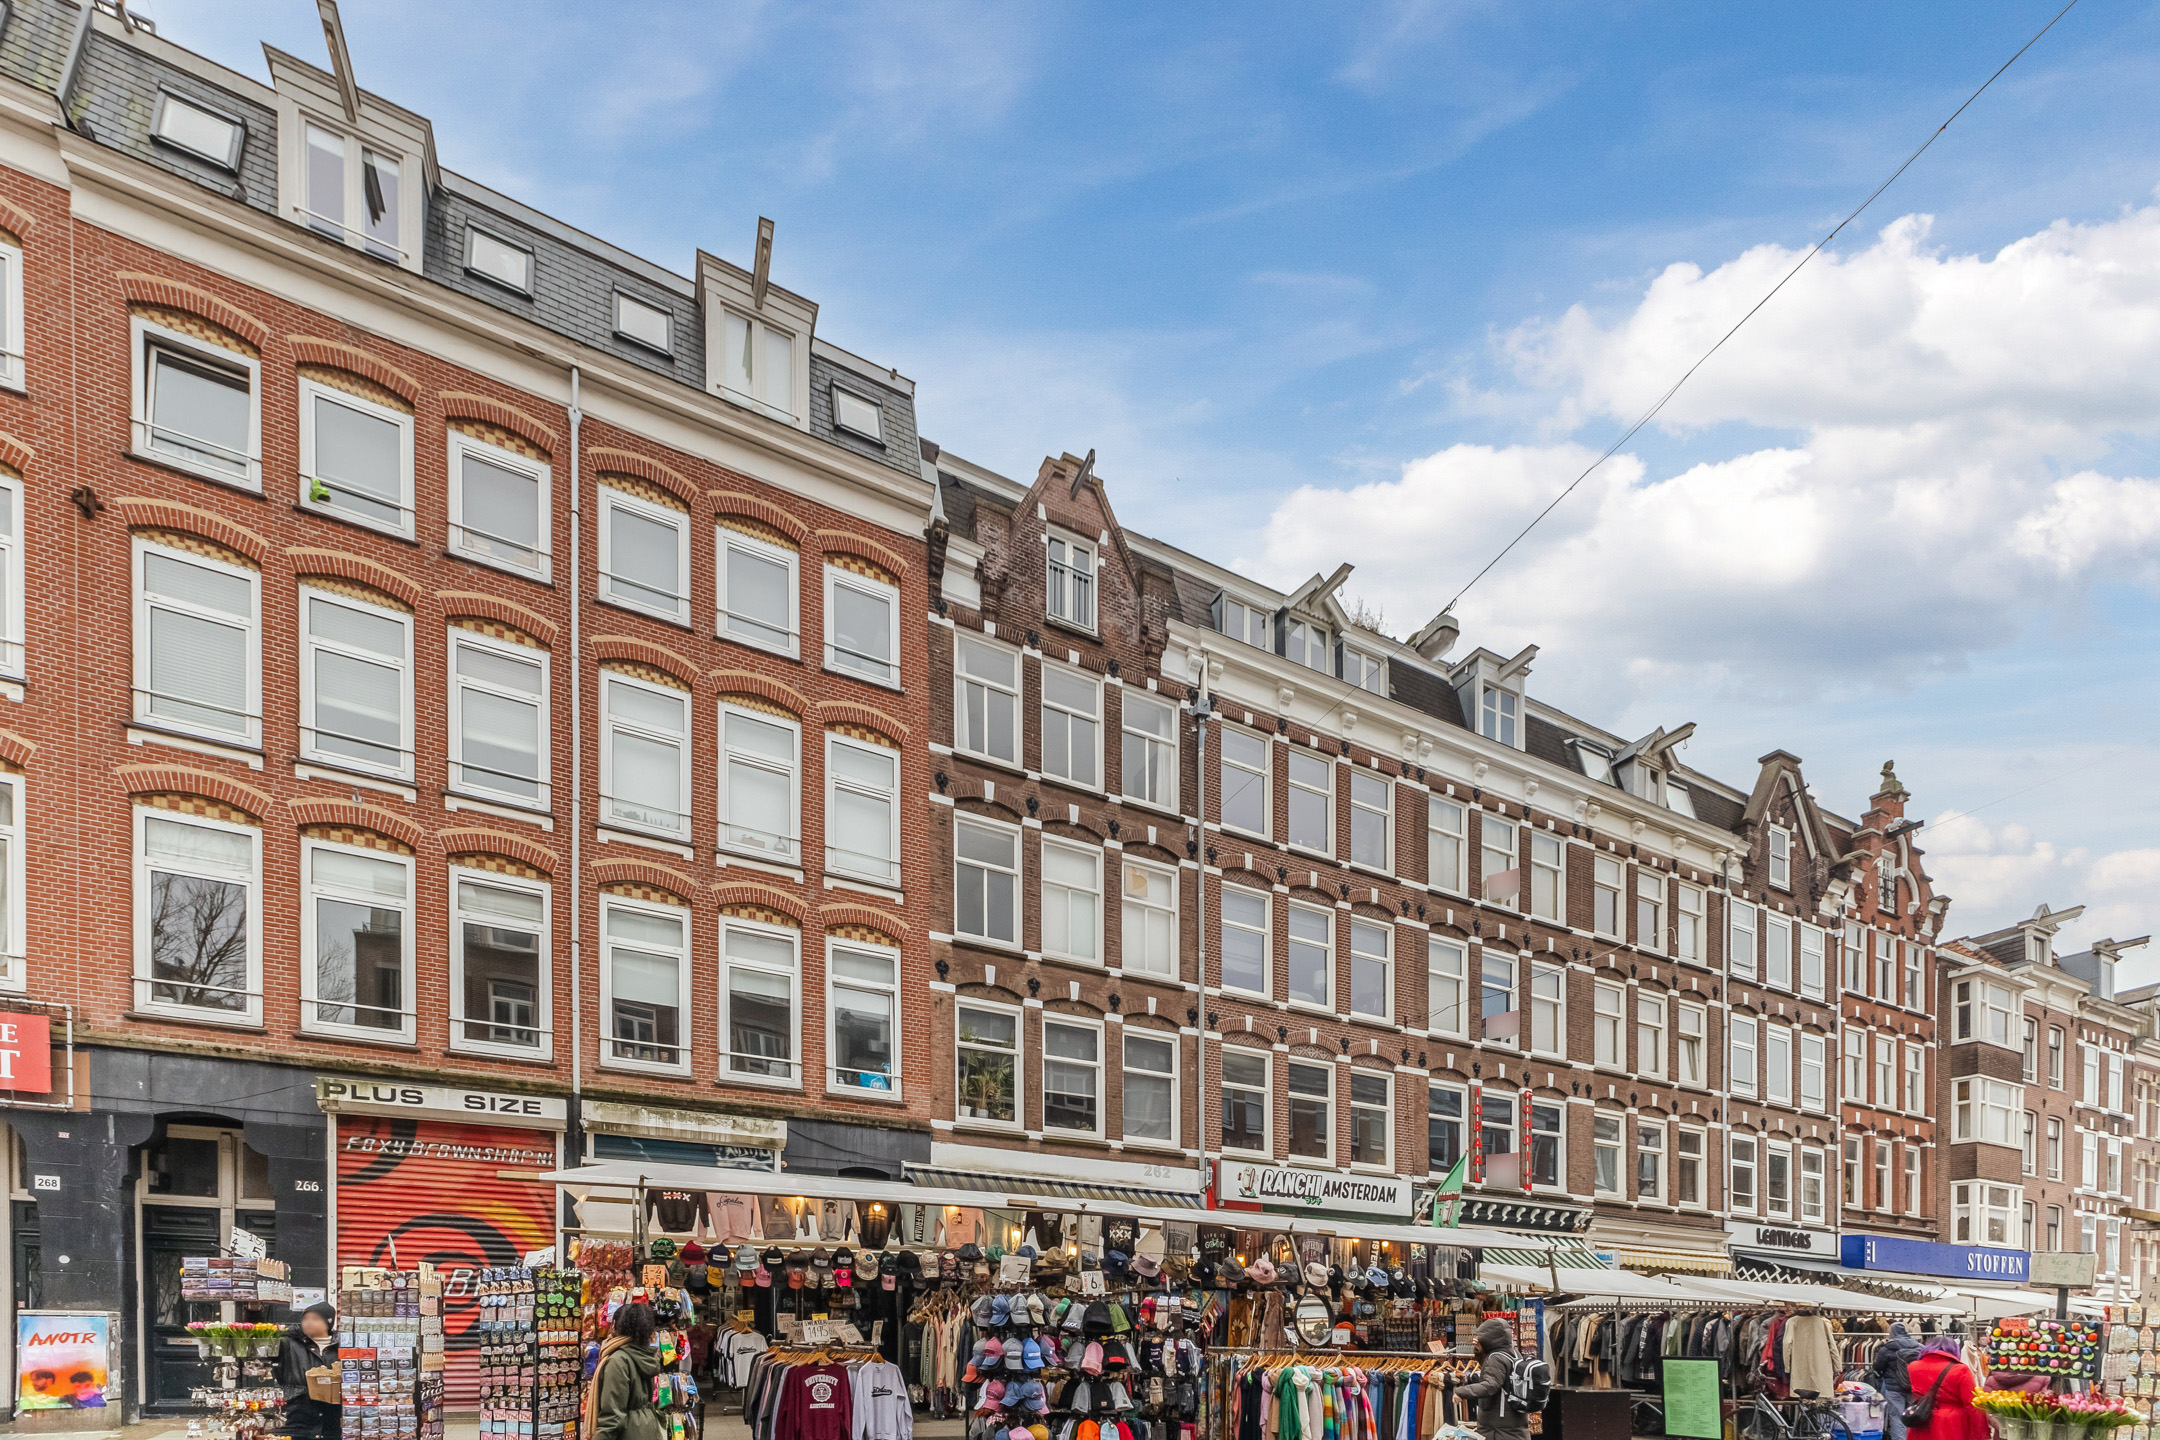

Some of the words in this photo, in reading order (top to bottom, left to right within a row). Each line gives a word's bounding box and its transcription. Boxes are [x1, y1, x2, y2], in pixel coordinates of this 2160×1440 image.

[323, 1082, 424, 1105] PLUS
[464, 1094, 542, 1115] SIZE
[1144, 1166, 1171, 1179] 262
[38, 1178, 58, 1188] 268
[1260, 1169, 1323, 1198] RANCHI
[1322, 1182, 1397, 1203] AMSTERDAM
[1304, 1196, 1322, 1206] ランチ
[1756, 1228, 1811, 1249] LEATHERS
[1967, 1252, 2023, 1275] STOFFEN
[804, 1319, 827, 1327] SWEATER
[28, 1332, 97, 1347] ANOTR
